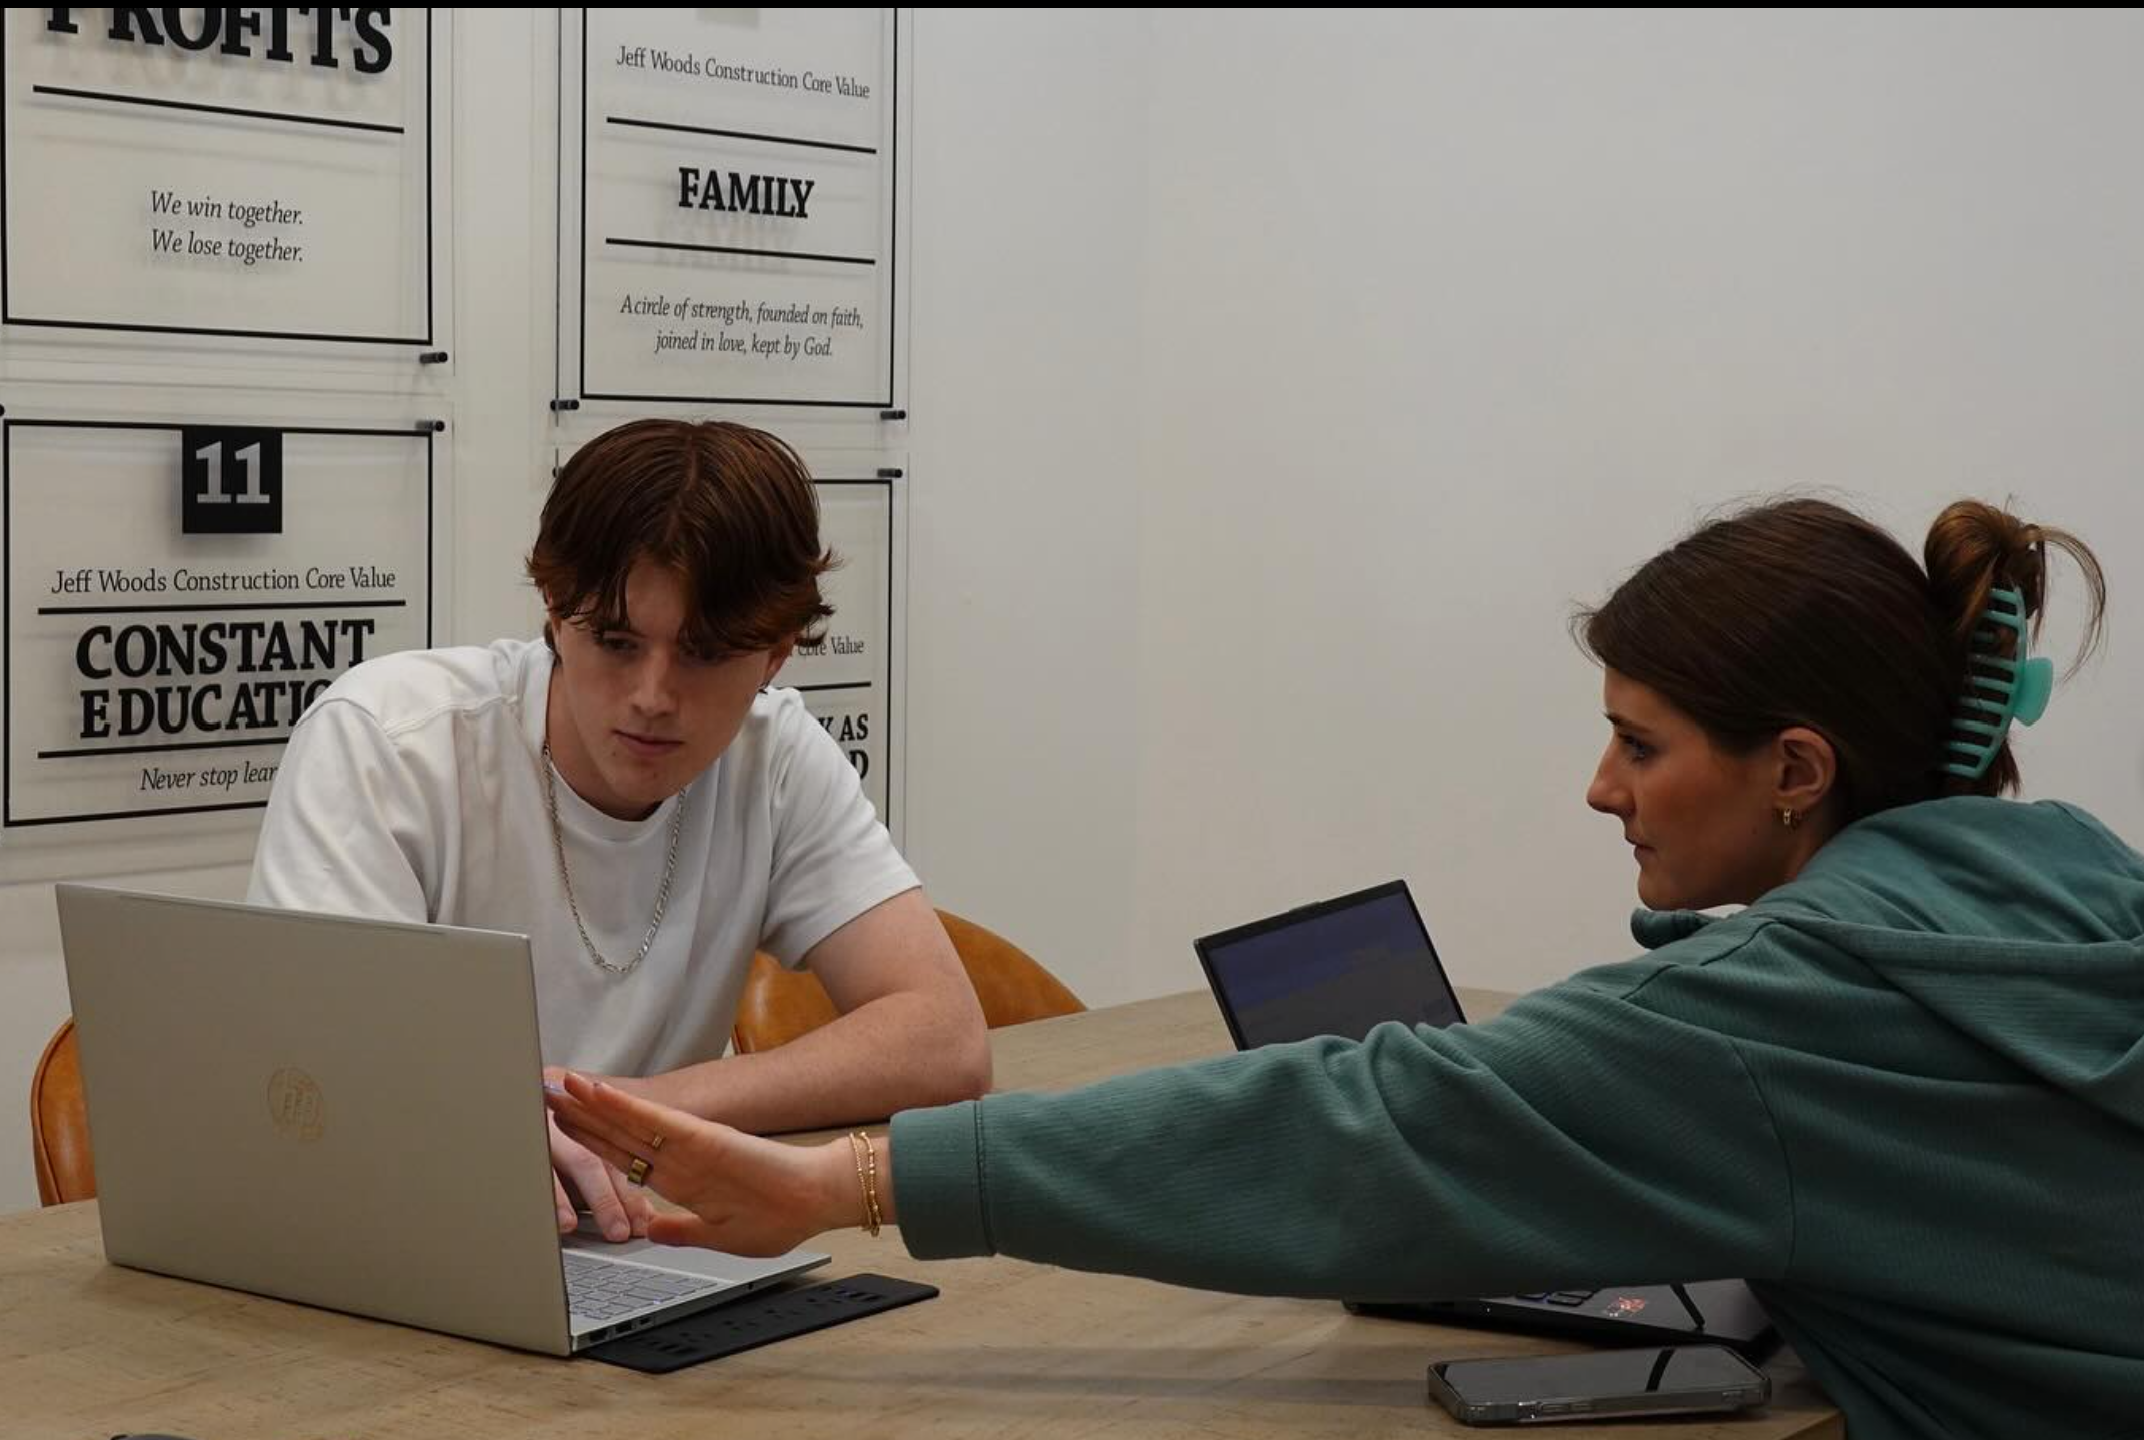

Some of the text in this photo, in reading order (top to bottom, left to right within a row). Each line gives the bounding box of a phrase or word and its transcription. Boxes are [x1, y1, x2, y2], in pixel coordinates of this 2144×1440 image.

[616, 45, 871, 99] Jeff Woods Construction Core Value
[151, 190, 304, 228] We win together.
[678, 167, 815, 218] FAMILY
[152, 228, 304, 266] We lose together.
[673, 297, 691, 321] of
[691, 300, 753, 326] strength,
[756, 301, 810, 325] founded
[812, 311, 828, 325] on
[830, 306, 864, 330] faith,
[654, 329, 833, 361] joined in love, kept by God.
[195, 440, 271, 504] 11
[51, 566, 397, 594] Jeff Woods Construction Core Value
[76, 619, 375, 679] CONSTANT
[831, 635, 864, 655] Value
[839, 713, 869, 742] AS
[140, 768, 196, 792] Never
[199, 767, 239, 791] stop
